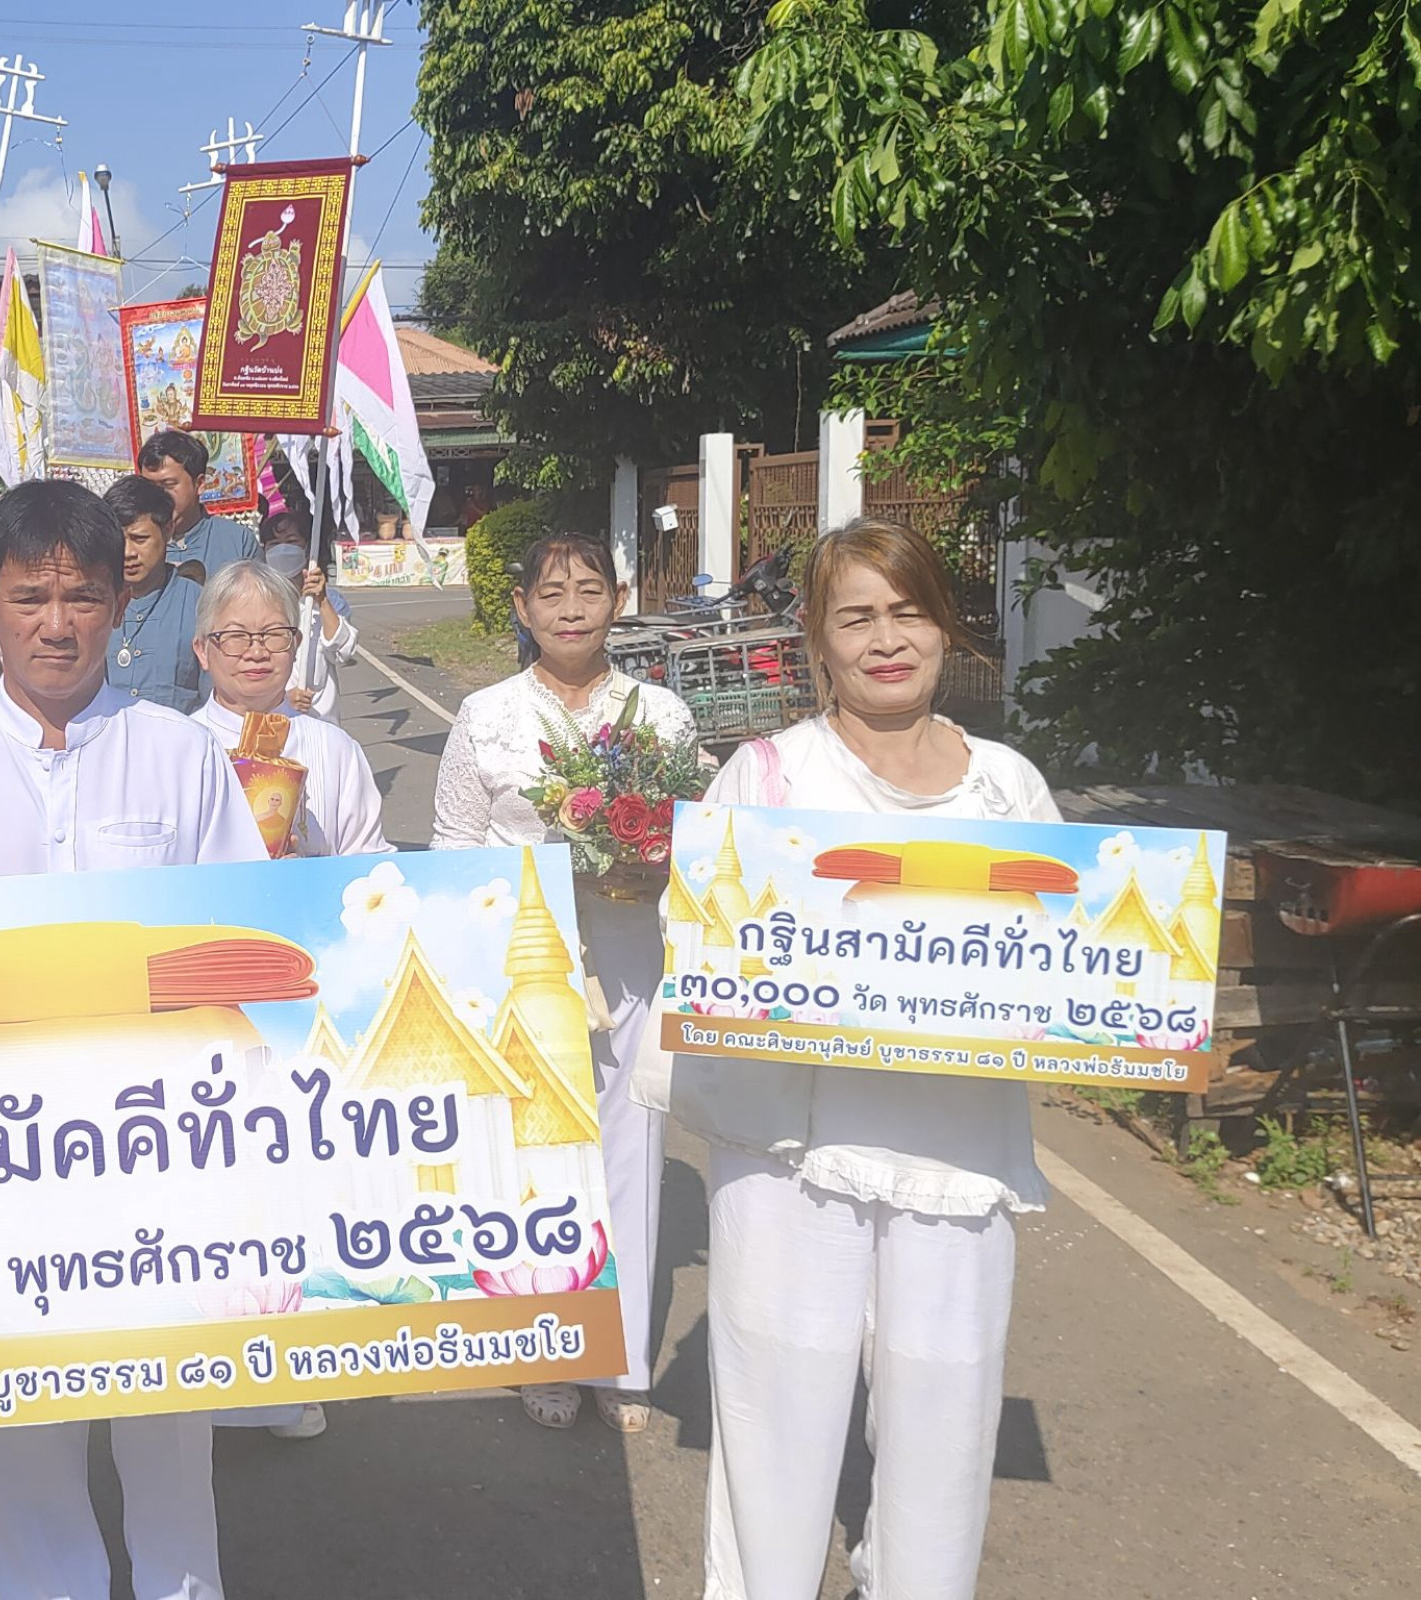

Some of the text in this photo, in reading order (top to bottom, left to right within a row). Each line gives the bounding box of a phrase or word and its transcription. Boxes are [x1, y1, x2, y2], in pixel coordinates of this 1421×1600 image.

[739, 911, 1142, 977] กฐินสามัคคีทั่วไทย
[681, 974, 1196, 1033] ๓๐,๐๐๐ วัด พุทธศักราช ๒๕๖๘
[683, 1025, 1186, 1079] โดย คณะศิษยานุศิษย์ บูชาธรรม ๘๑ ปี หลวงพ่อธัมมชโย
[7, 1228, 306, 1316] พุทธศักราช
[329, 1195, 582, 1270] ๒๕๖๘
[180, 1359, 232, 1384] ๘๑
[247, 1340, 272, 1378] ปี
[289, 1319, 580, 1375] หลวงพ่อธัมมชโย
